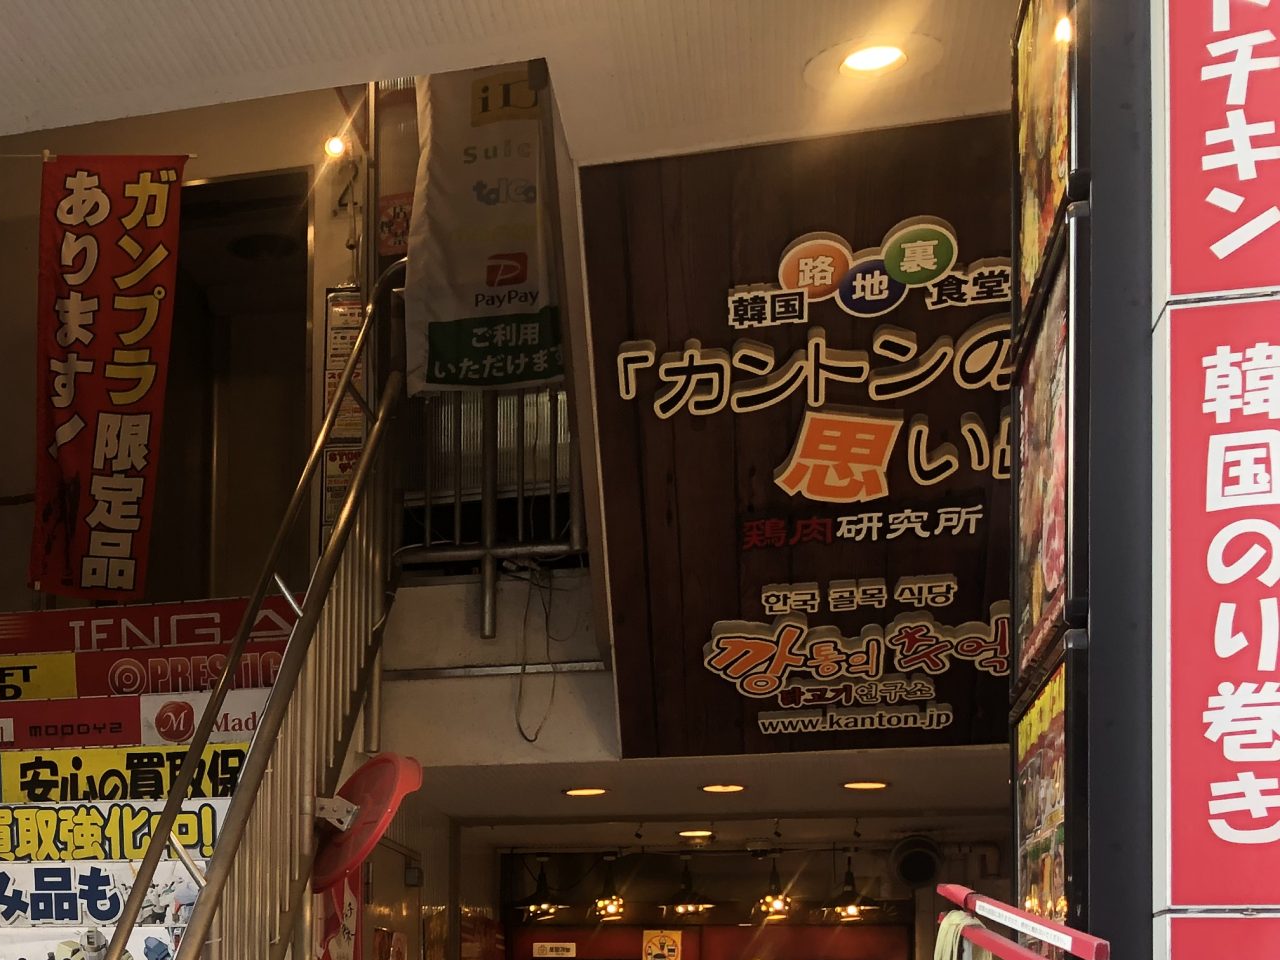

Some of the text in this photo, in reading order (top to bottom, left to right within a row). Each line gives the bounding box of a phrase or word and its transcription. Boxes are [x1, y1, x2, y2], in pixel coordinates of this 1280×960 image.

[474, 289, 539, 308] PayPay
[730, 291, 807, 326] 韓国
[930, 268, 1010, 305] 食堂
[471, 322, 539, 348] ご利用
[80, 168, 178, 591] ガンプラ限定品
[743, 505, 984, 549] 鶏肉研究所
[762, 582, 956, 615] 한국 골목 식당
[1201, 344, 1280, 845] 韓国のり巻き
[147, 651, 285, 694] PRESTIG
[704, 617, 1010, 698] 깡통의 추억
[210, 711, 258, 733] Mad
[759, 708, 953, 734] www.kanton.jp
